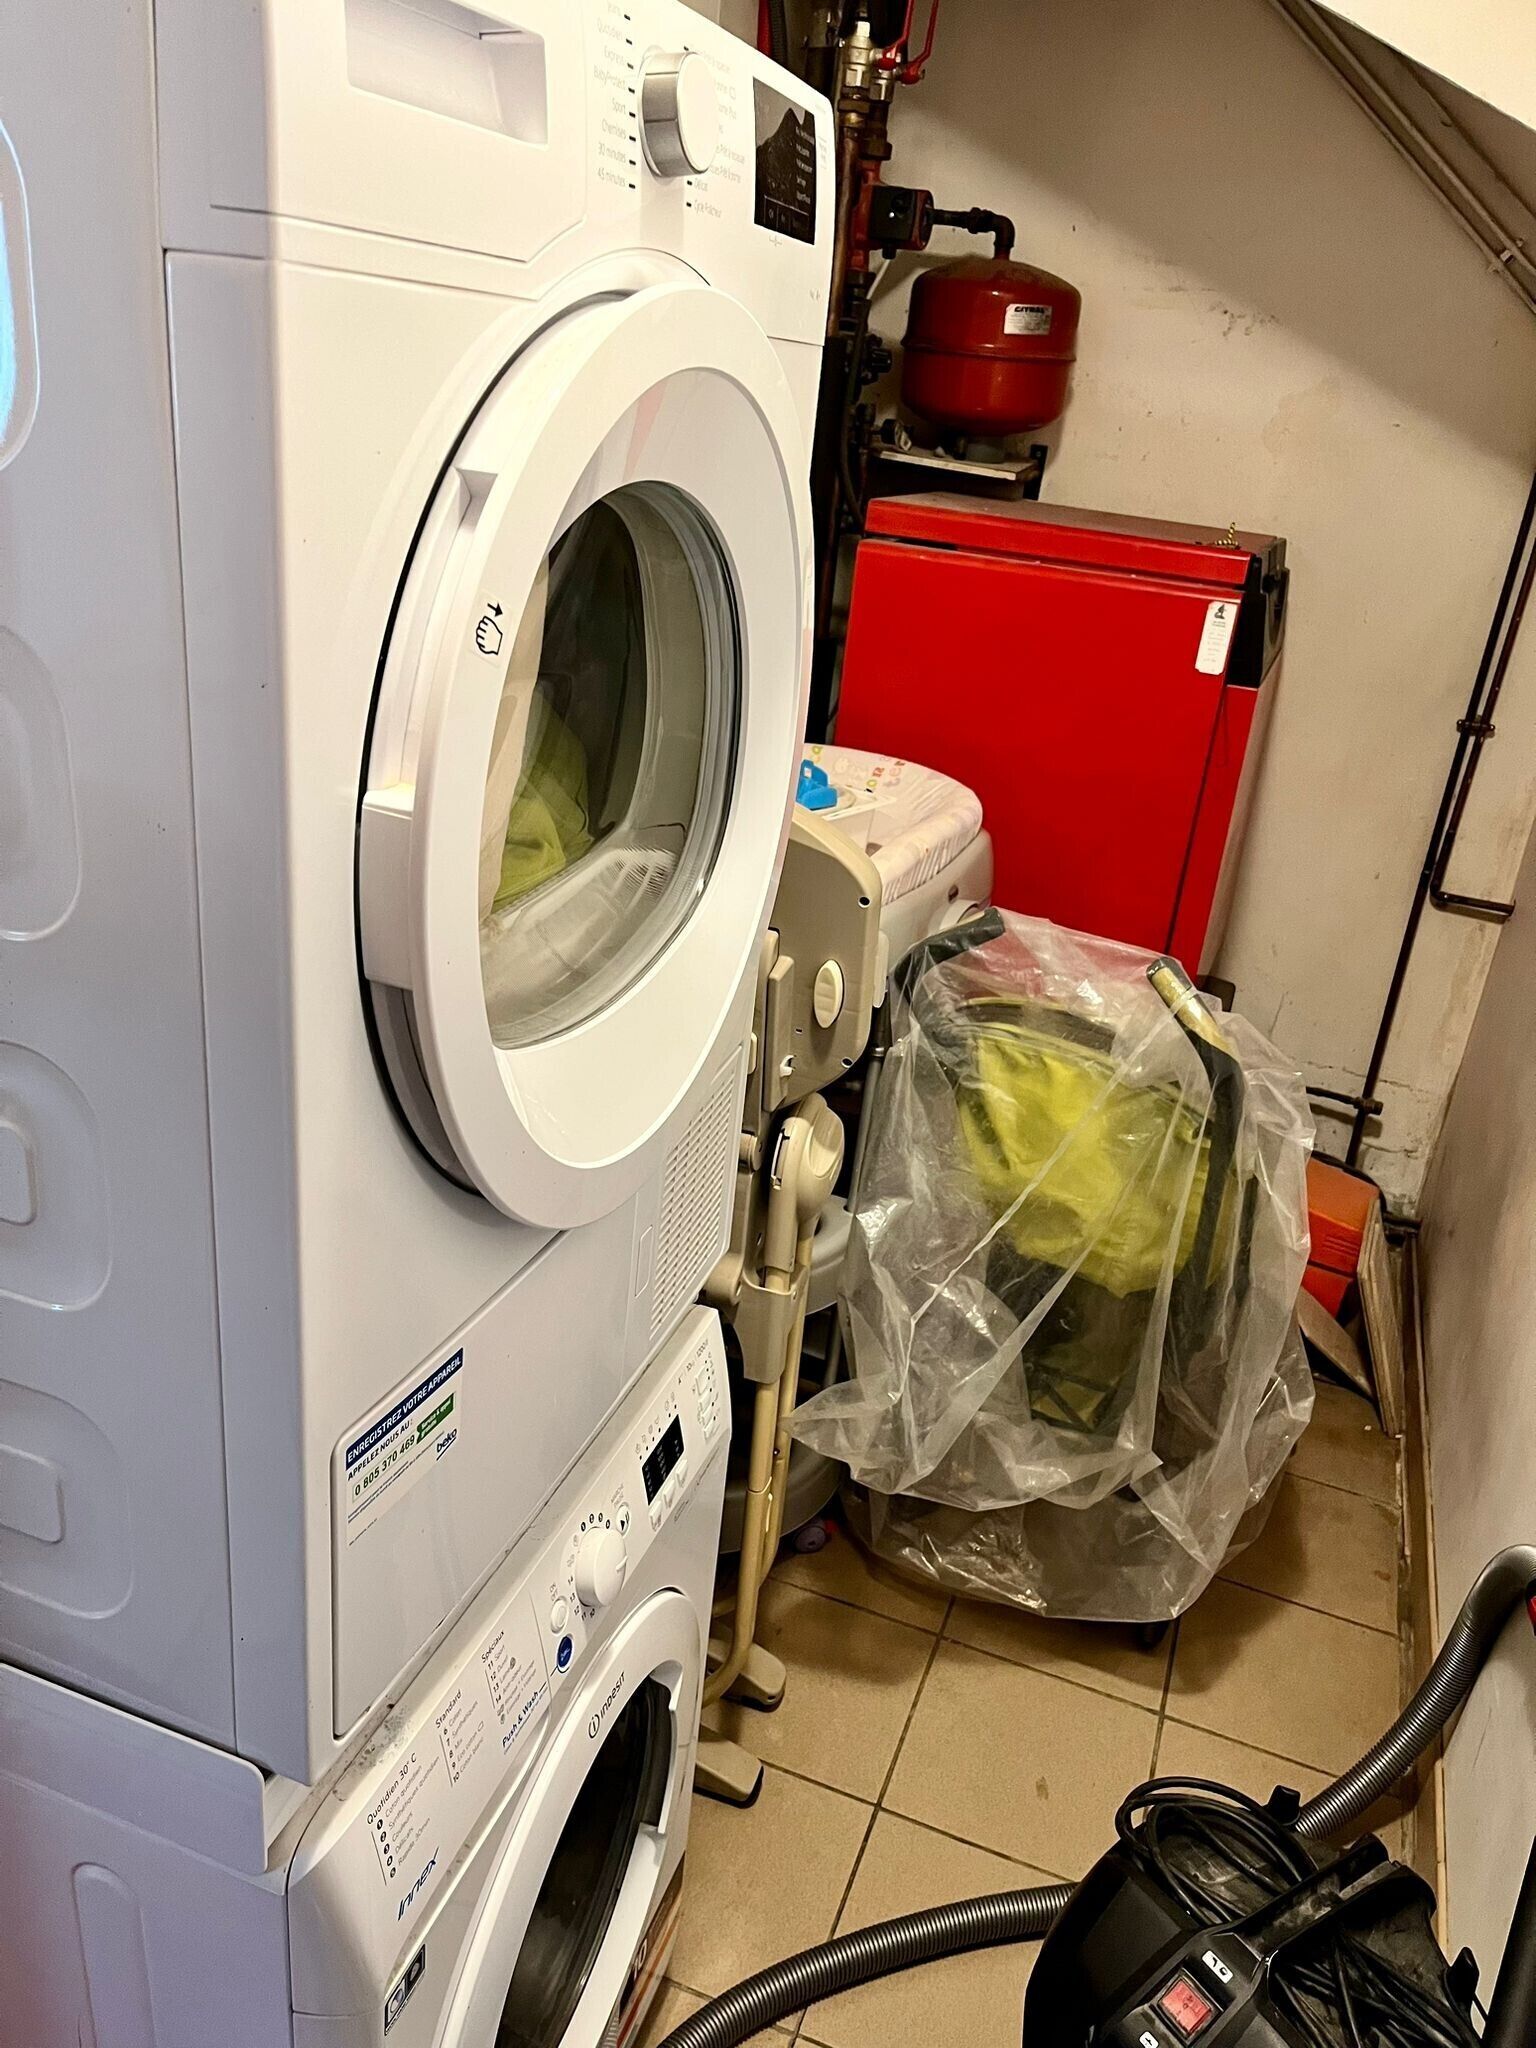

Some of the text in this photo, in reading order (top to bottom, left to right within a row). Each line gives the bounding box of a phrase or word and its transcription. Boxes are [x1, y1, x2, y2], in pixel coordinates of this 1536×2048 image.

[612, 97, 626, 113] Sport
[602, 118, 626, 140] Chemises
[598, 142, 626, 164] 30 minutes
[598, 167, 626, 188] 45 minutes
[348, 1410, 401, 1463] ENREGISTREZ
[402, 1387, 428, 1414] VOTRE
[427, 1356, 462, 1392] APPAREIL
[348, 1447, 380, 1481] APPELEZ
[380, 1429, 400, 1452] NOUS
[400, 1421, 410, 1435] AU
[436, 1428, 458, 1453] beko
[355, 1484, 361, 1496] 0
[363, 1469, 380, 1489] 805
[382, 1452, 398, 1472] 370
[399, 1435, 415, 1455] 469
[482, 1631, 505, 1663] Spéciaux
[488, 1660, 494, 1670] 11
[490, 1671, 497, 1682] 12
[493, 1682, 500, 1693] 13
[496, 1694, 502, 1704] 14
[435, 1689, 462, 1729] Standard
[502, 1723, 518, 1748] Push
[518, 1714, 523, 1725] &
[523, 1691, 539, 1715] Wash
[366, 1752, 417, 1825] Quotidien 30° C
[453, 1771, 460, 1783] 10
[385, 1796, 400, 1818] Coton
[400, 1765, 422, 1797] quotidien
[392, 1811, 413, 1842] Couleurs
